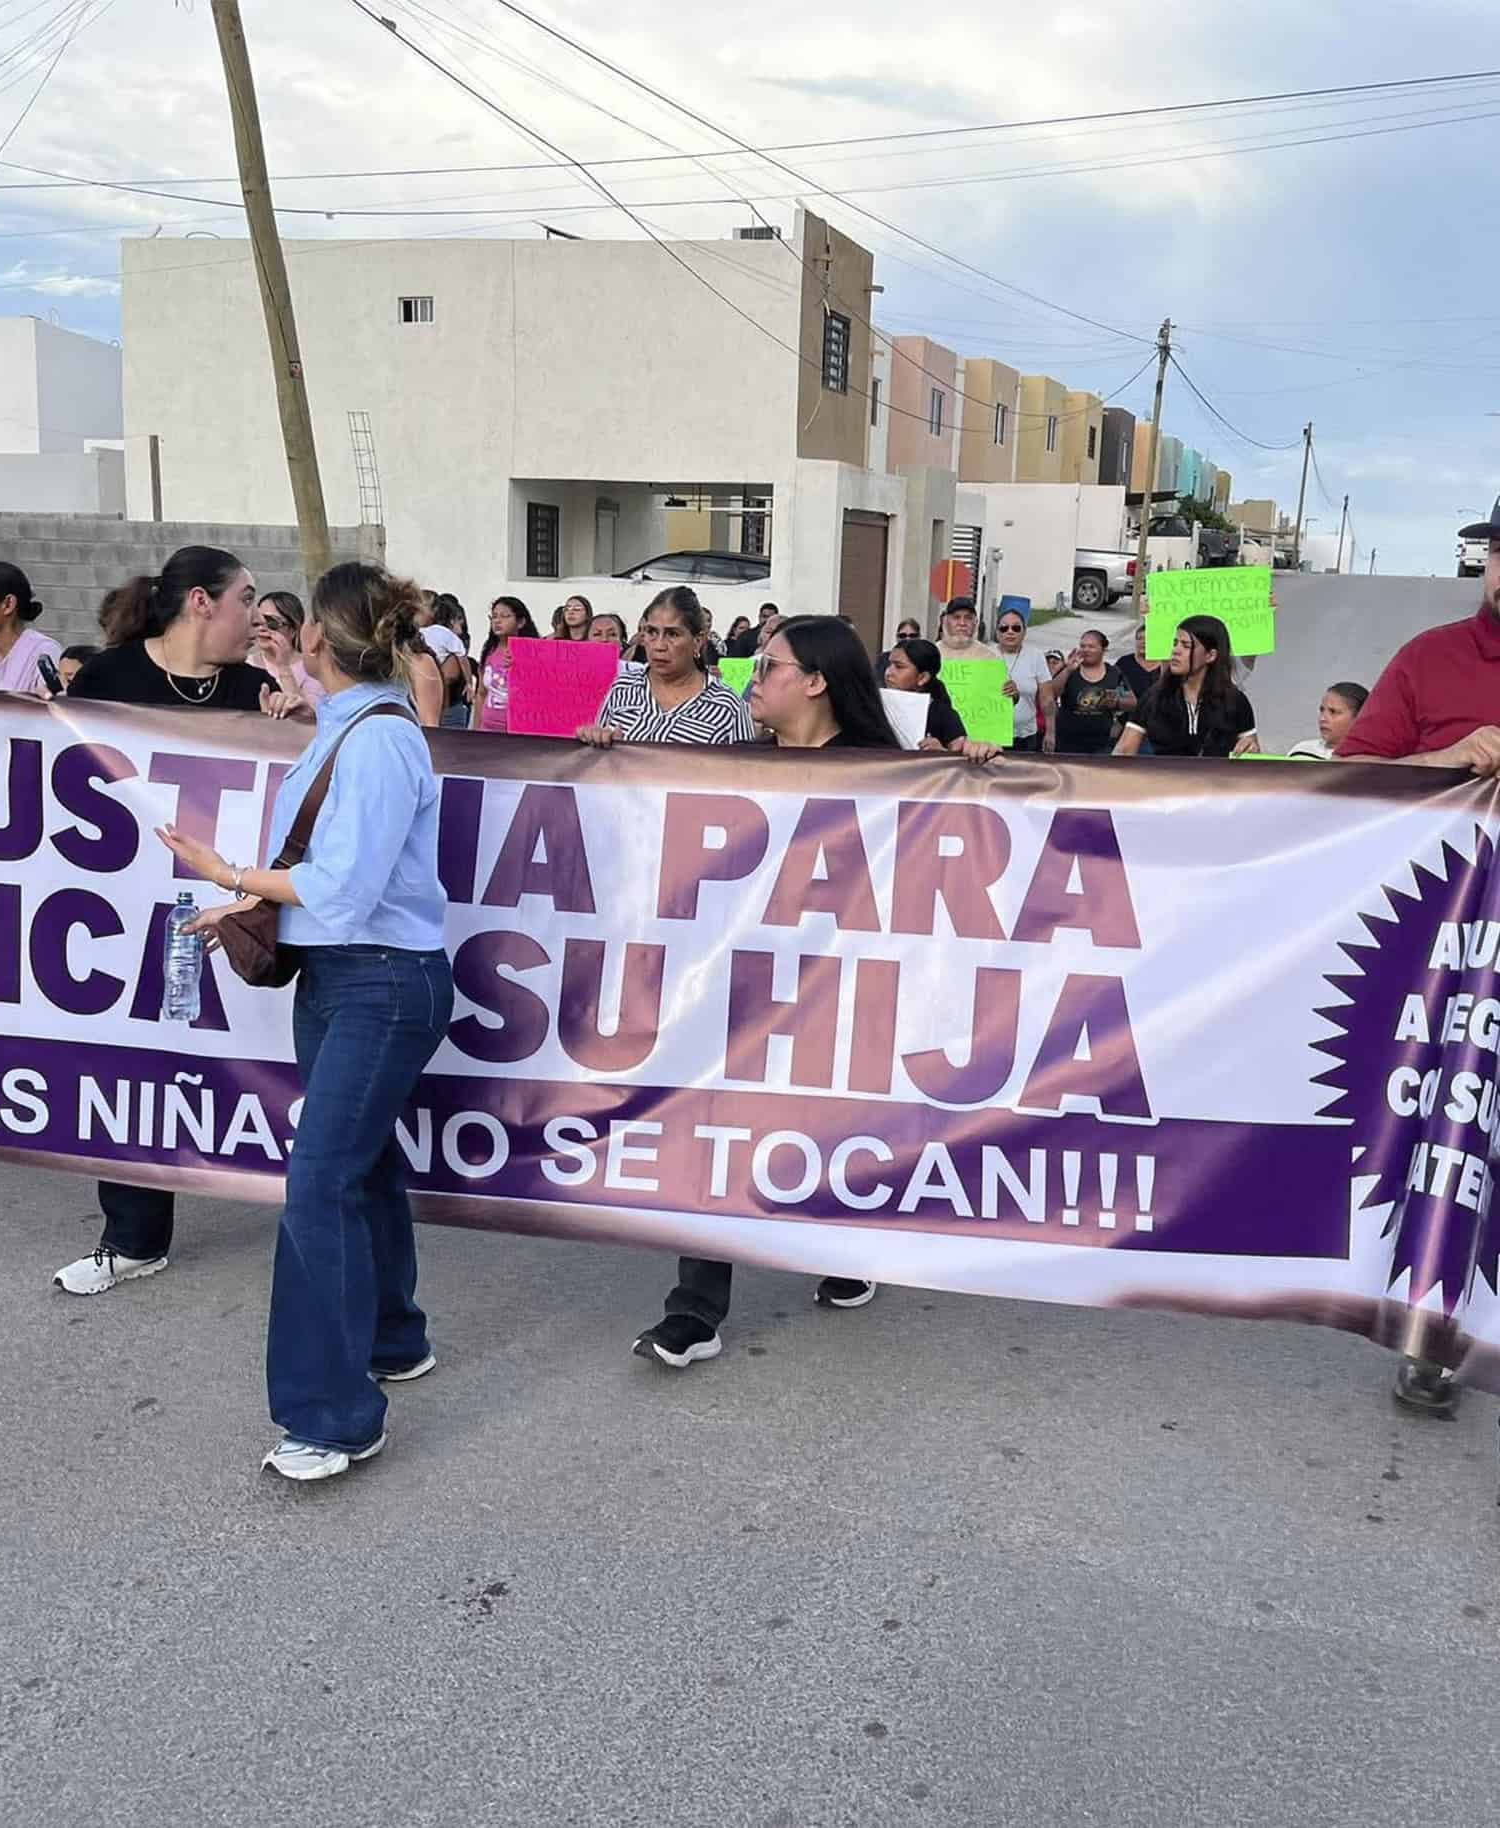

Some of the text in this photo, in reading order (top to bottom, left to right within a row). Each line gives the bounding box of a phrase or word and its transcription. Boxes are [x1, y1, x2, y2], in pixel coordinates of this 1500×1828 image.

[656, 790, 1142, 949] PARA
[448, 929, 666, 1072] SU
[724, 949, 1152, 1119] HIJA
[1394, 993, 1431, 1044] A
[78, 1072, 306, 1162] NIÑA
[395, 1107, 510, 1178] NO
[540, 1116, 661, 1193] SE
[694, 1124, 1156, 1232] TOCAN!!!
